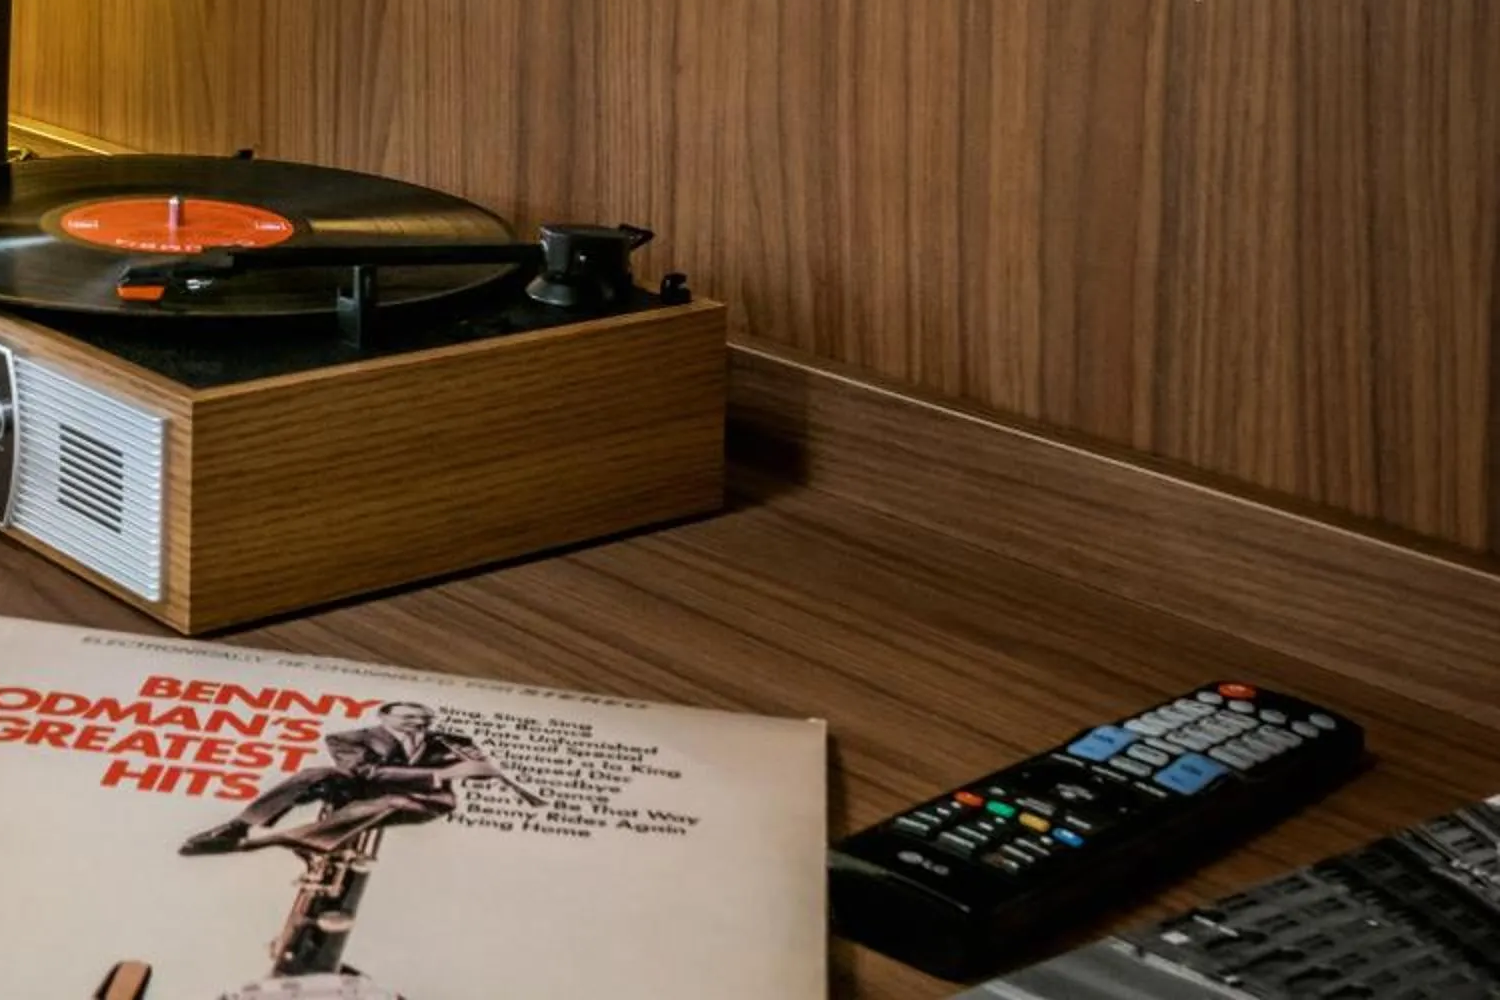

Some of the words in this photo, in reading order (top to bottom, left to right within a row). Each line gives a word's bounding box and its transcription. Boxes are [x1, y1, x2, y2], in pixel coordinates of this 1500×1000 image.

[139, 675, 384, 719] BENNY
[444, 715, 506, 730] Jersey
[515, 723, 593, 738] Bounce
[548, 717, 593, 732] Sing
[481, 738, 558, 755] Airmail
[566, 746, 643, 763] Special
[529, 733, 658, 756] Unfurnished
[490, 749, 573, 767] Clarinet
[631, 763, 682, 779] King
[499, 760, 581, 779] Slipped
[588, 770, 632, 783] Disc
[100, 759, 264, 801] HITS
[515, 774, 621, 794] Goodbye
[538, 787, 609, 803] Dance
[446, 811, 514, 832] Flying
[522, 821, 592, 838] Home
[466, 803, 539, 820] Benny
[546, 811, 608, 827] Rides
[615, 818, 687, 836] Again
[553, 799, 582, 812] Be
[592, 803, 638, 818] That
[647, 808, 700, 827] Way
